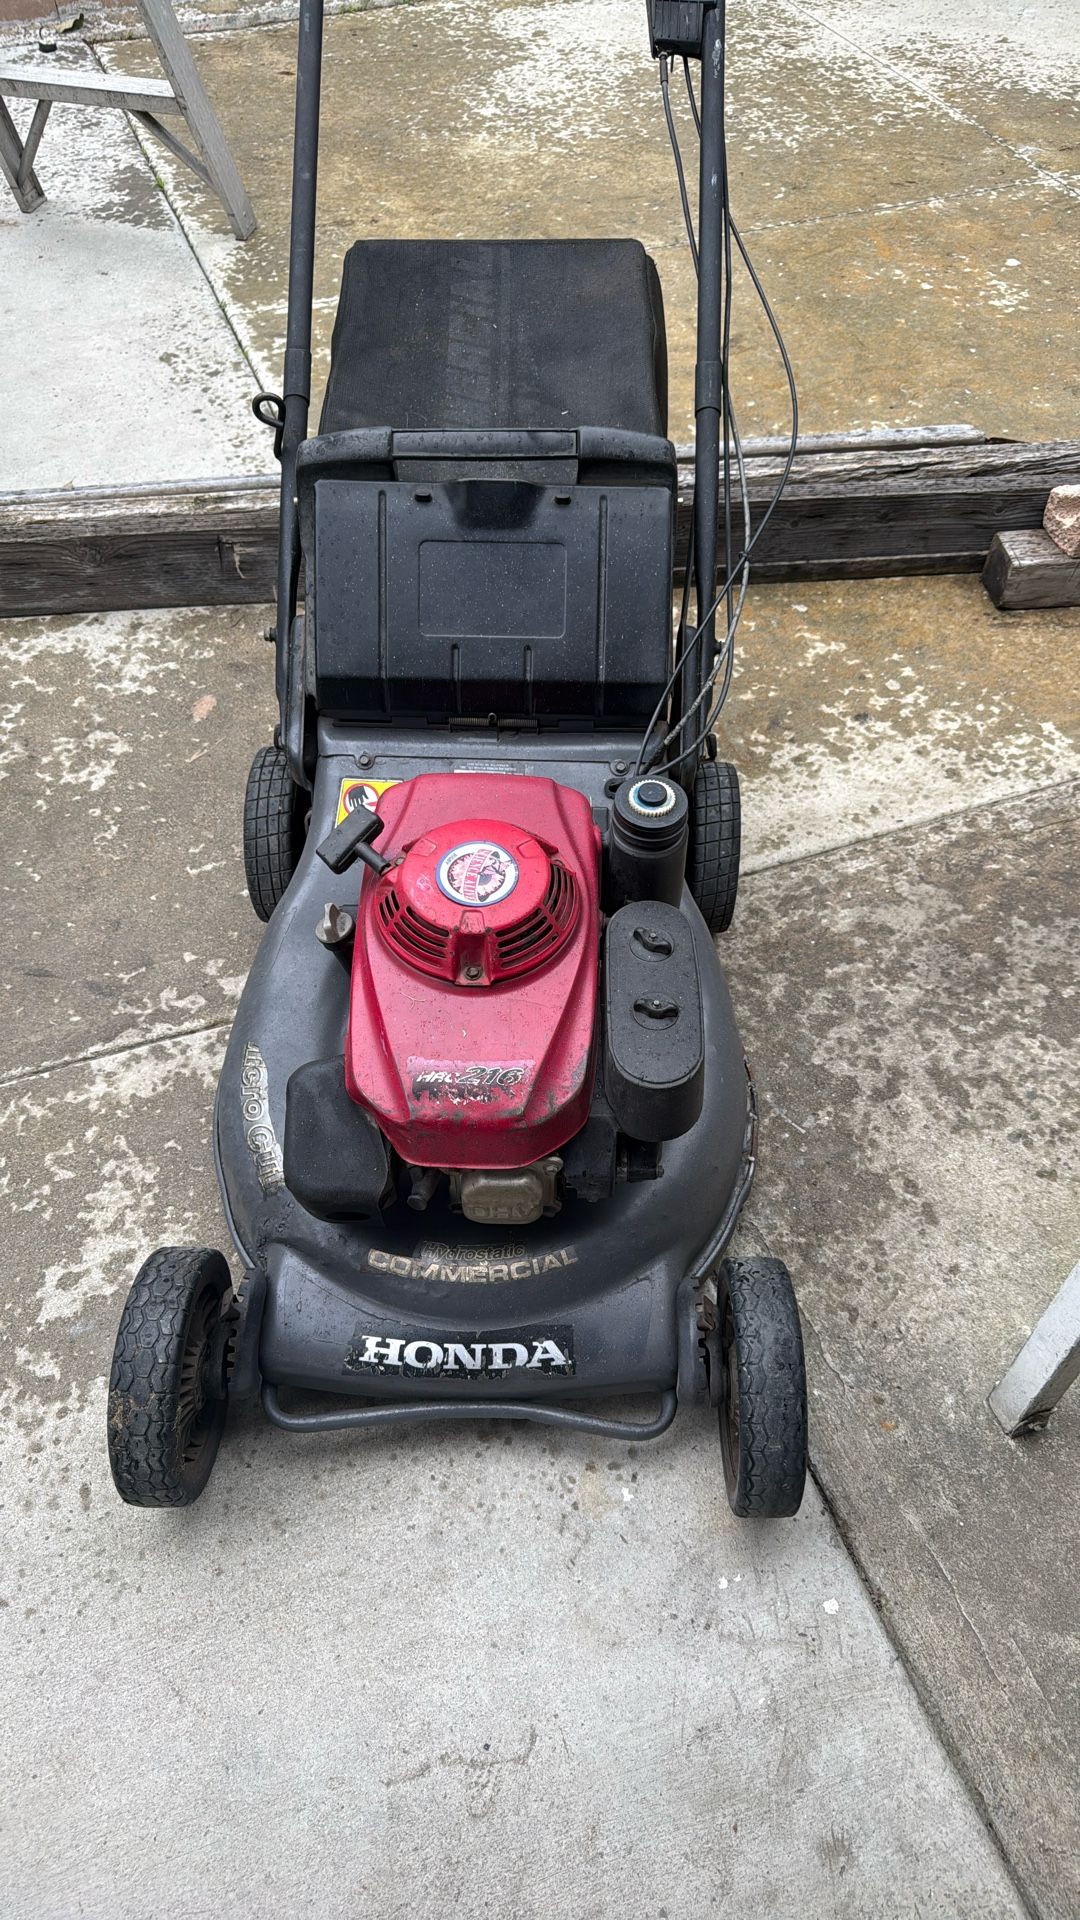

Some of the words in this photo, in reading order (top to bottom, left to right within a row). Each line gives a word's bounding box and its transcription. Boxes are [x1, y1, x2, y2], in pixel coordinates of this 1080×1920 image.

[466, 1202, 534, 1219] OHV
[368, 1248, 579, 1284] COMMERCIAL
[421, 1241, 526, 1263] Hydrostatic
[358, 1335, 573, 1370] HONDA
